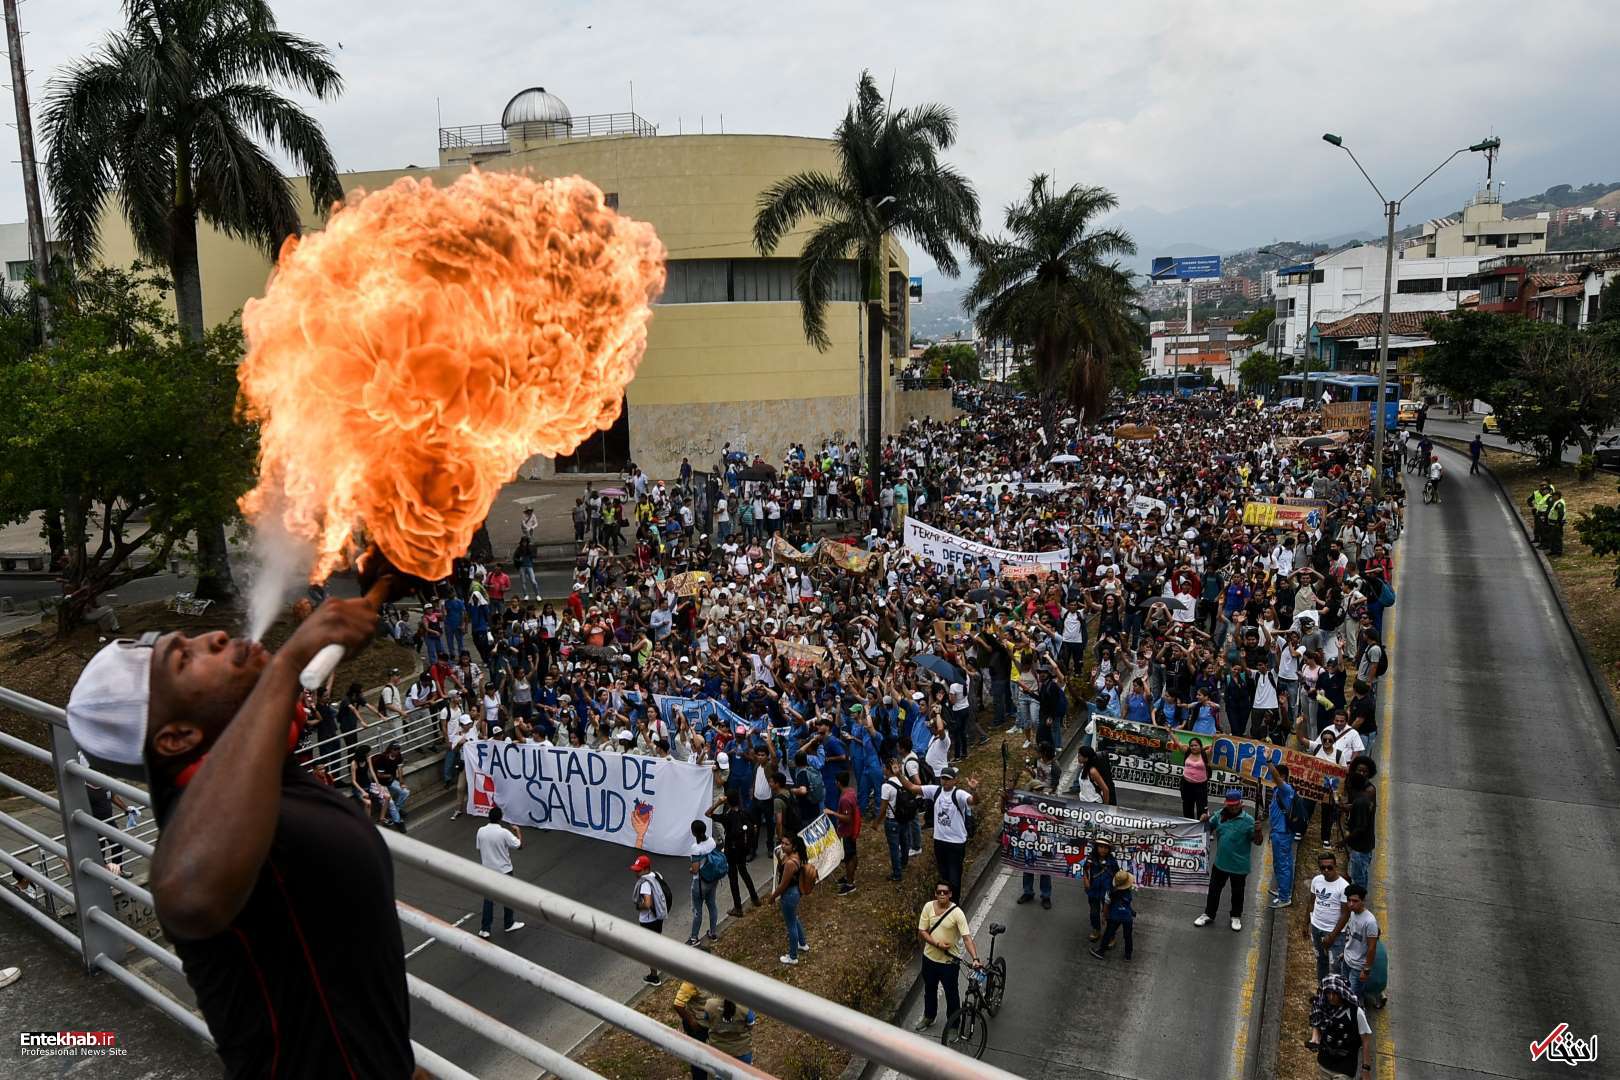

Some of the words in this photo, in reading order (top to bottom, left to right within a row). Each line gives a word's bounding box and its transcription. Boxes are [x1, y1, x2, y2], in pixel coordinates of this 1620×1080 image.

[1243, 503, 1277, 527] APH
[476, 743, 608, 786] FACULTAD
[622, 755, 657, 796] DE
[1107, 753, 1242, 785] PRESETE
[1212, 736, 1283, 781] APH
[525, 780, 628, 833] SALUD
[1038, 802, 1091, 822] Consejo
[1037, 821, 1092, 839] Raisalez
[1010, 836, 1053, 853] Sector
[1056, 841, 1080, 855] Las
[1135, 850, 1200, 871] (Navarro)
